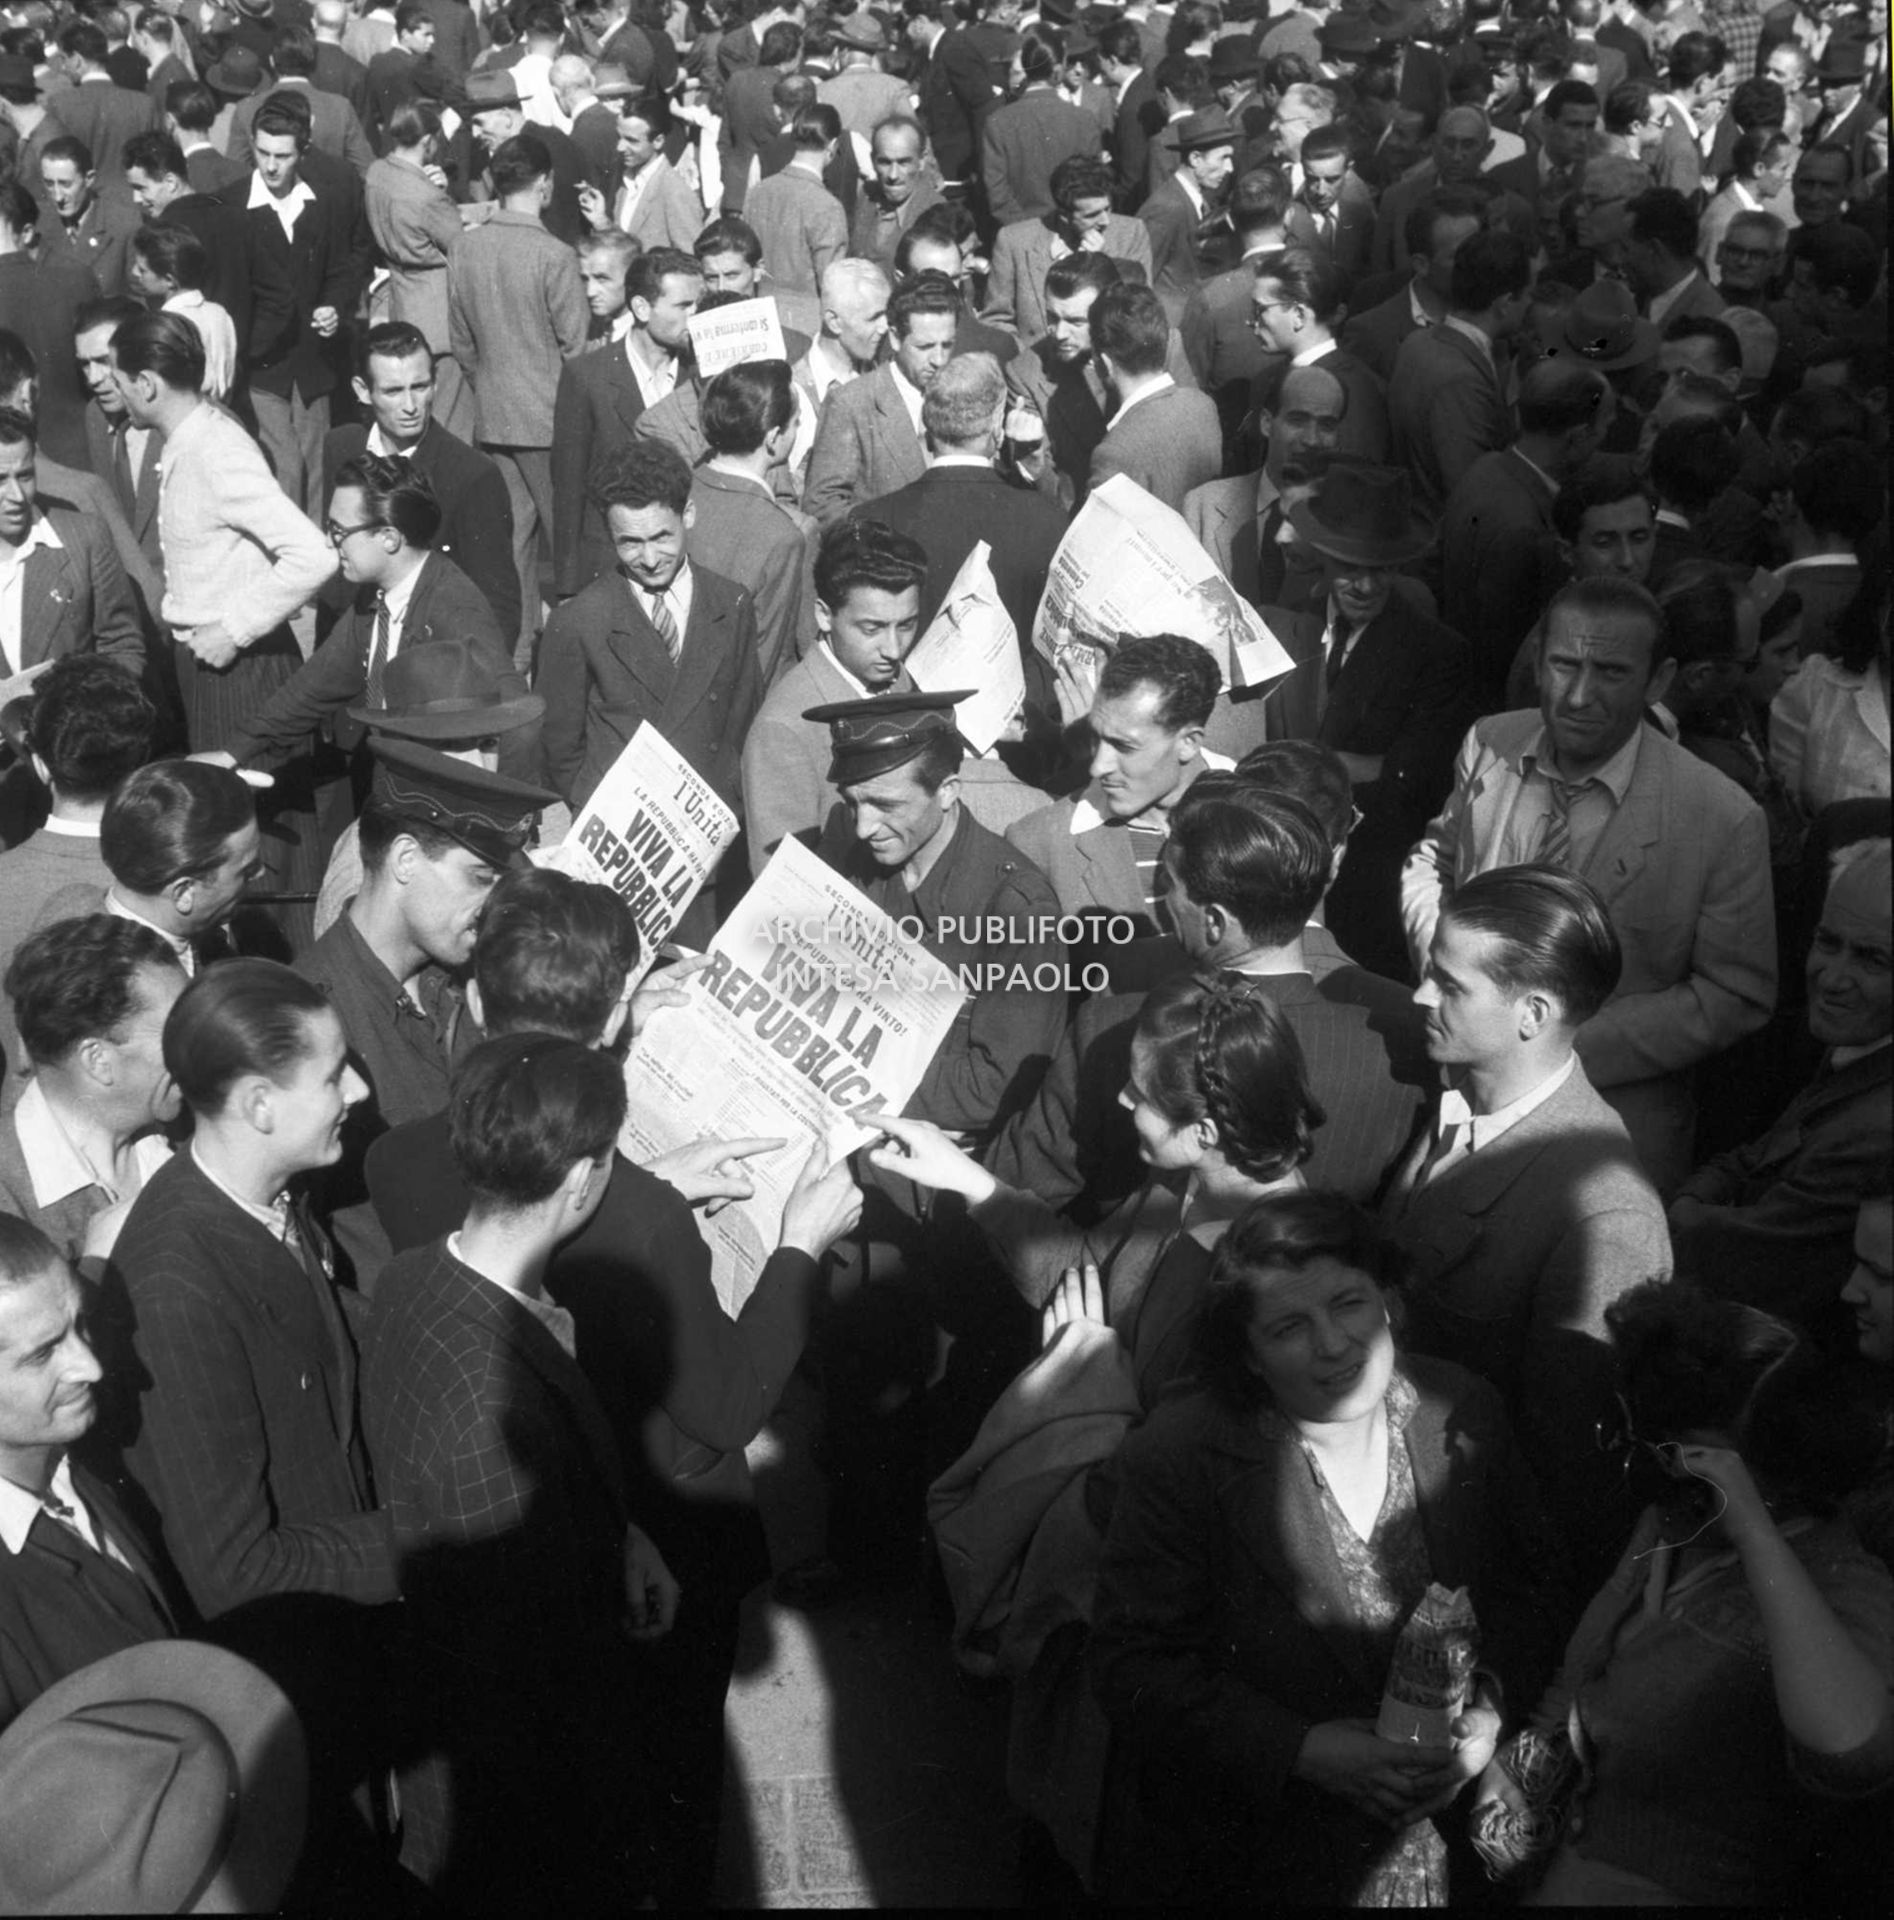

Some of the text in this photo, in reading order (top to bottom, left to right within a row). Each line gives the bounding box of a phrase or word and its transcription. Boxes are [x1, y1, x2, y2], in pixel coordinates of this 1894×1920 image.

[634, 787, 647, 801] LA
[646, 801, 690, 853] REPUBBLICA
[673, 780, 722, 847] l'Unità
[678, 764, 710, 800] SECONDA
[625, 809, 693, 908] VIVA LA
[823, 884, 915, 966] SECONDA EDIZIONE
[761, 943, 842, 1029] VIVA
[836, 1006, 883, 1069] LA
[789, 930, 858, 990] REPUBBLICA
[856, 991, 872, 1005] HA
[872, 1001, 907, 1036] VINTO!
[699, 950, 888, 1128] REPUBBLICA
